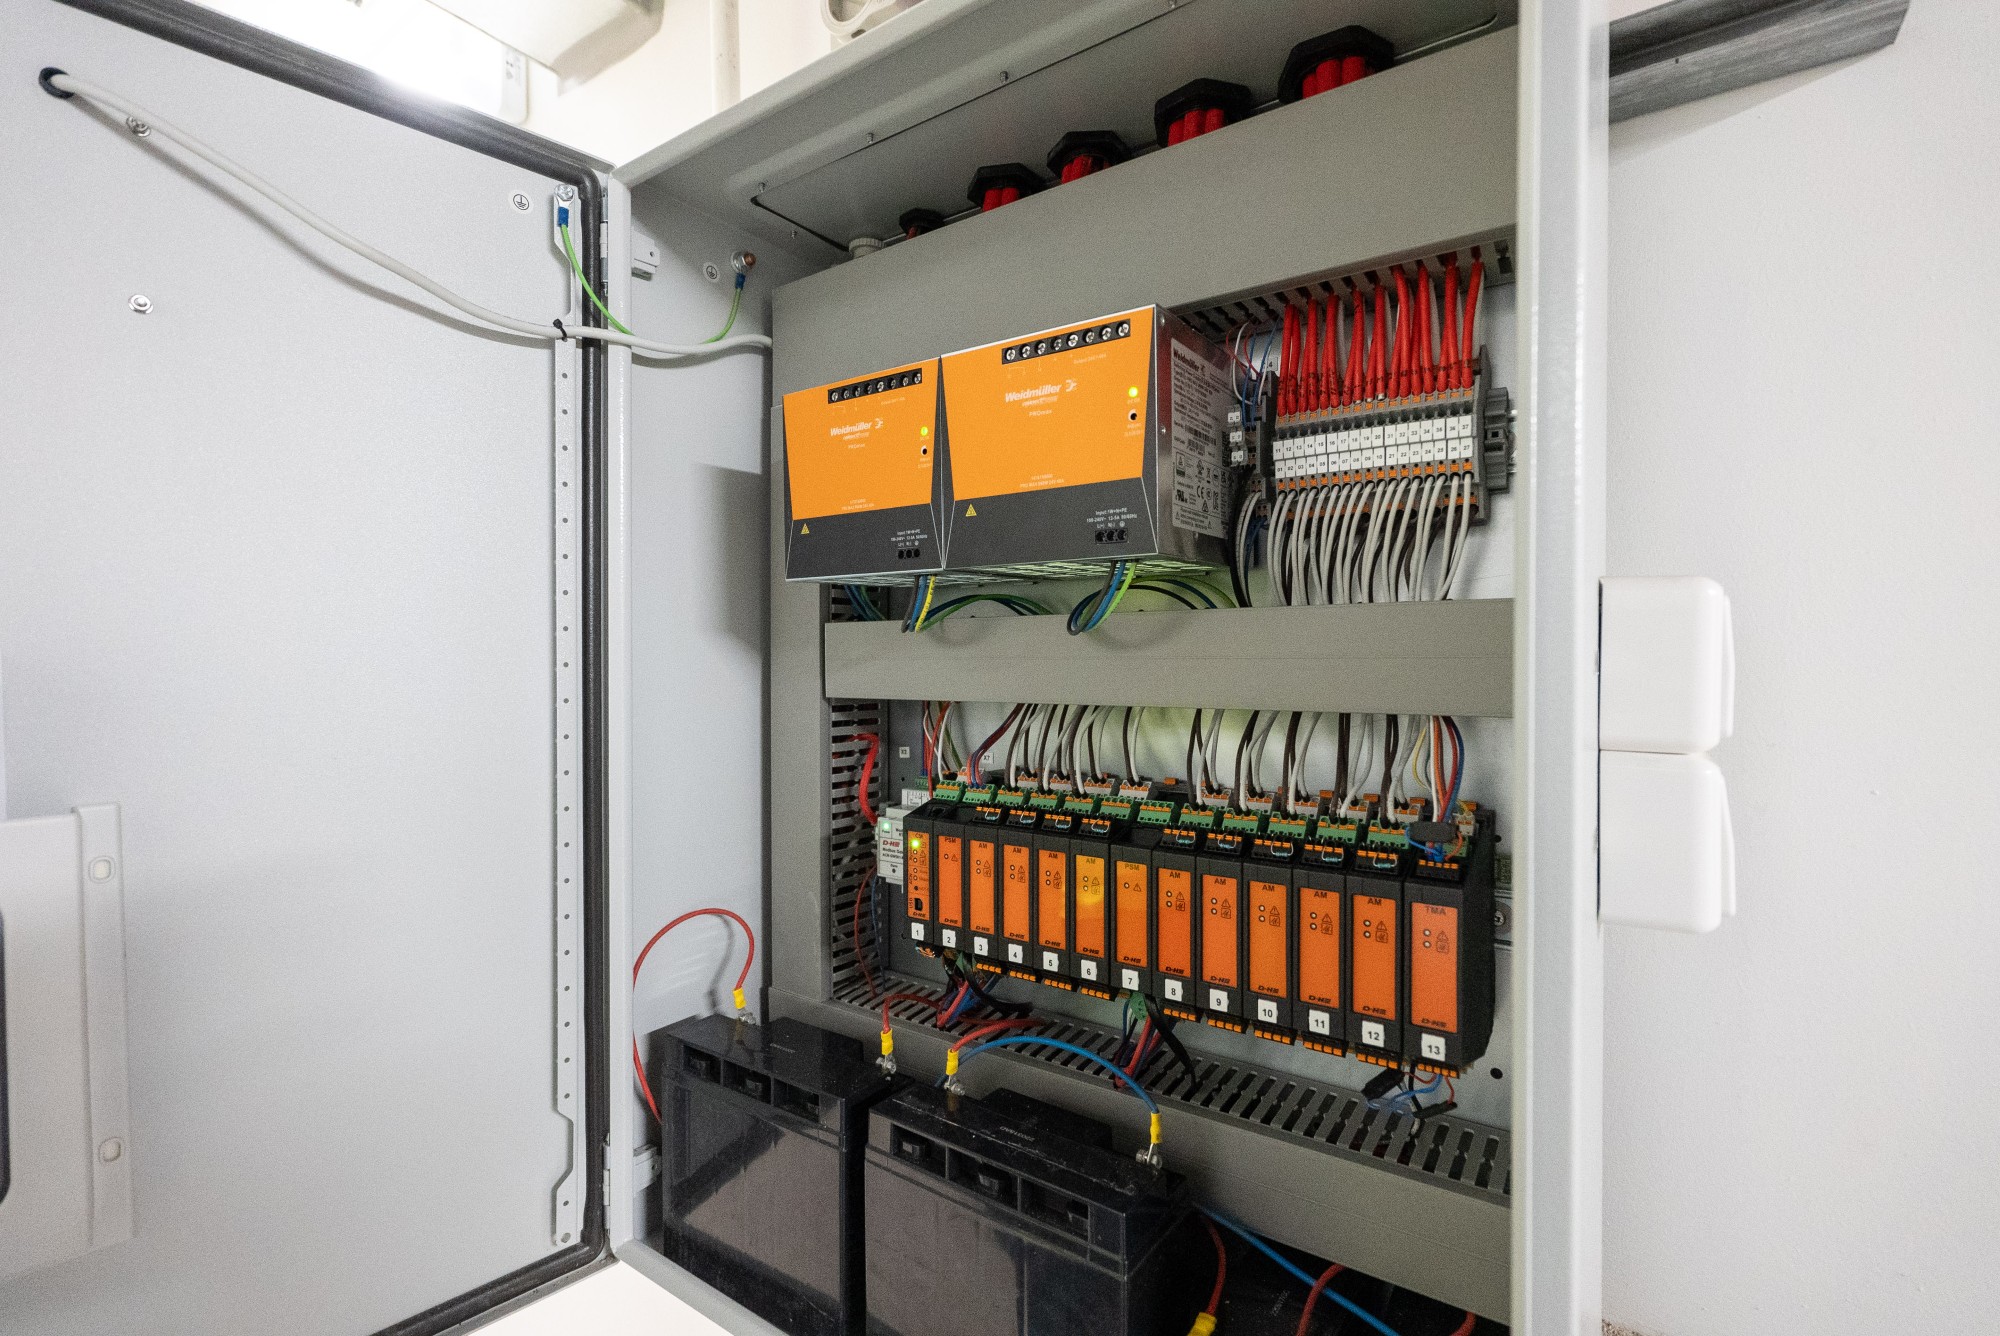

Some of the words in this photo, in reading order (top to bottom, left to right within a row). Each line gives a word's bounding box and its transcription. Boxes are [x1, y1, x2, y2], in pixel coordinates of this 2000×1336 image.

[1005, 383, 1062, 402] Weidmüller
[830, 420, 872, 436] Weidmüller
[1125, 863, 1140, 871] PSM
[1367, 898, 1382, 906] AM
[1425, 906, 1446, 915] TMA
[1262, 1008, 1273, 1018] 10
[1315, 1019, 1325, 1029] 11
[1368, 1031, 1380, 1041] 12
[1428, 1044, 1440, 1055] 13
